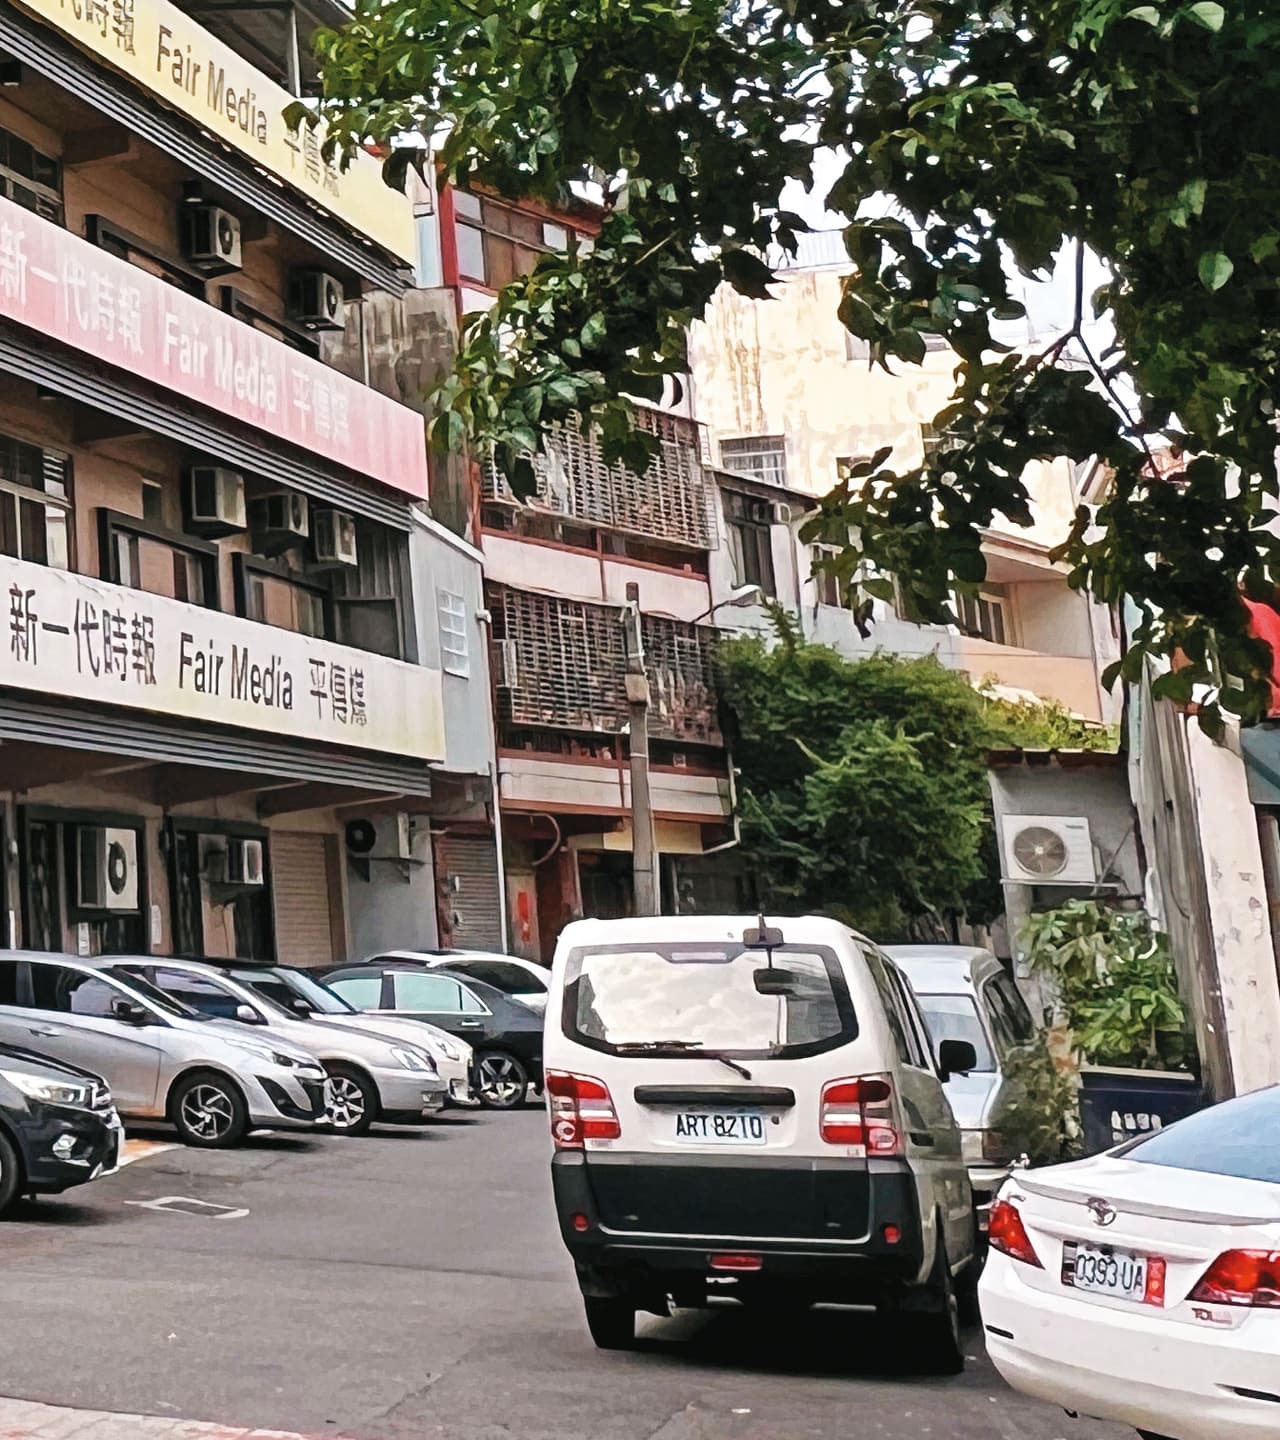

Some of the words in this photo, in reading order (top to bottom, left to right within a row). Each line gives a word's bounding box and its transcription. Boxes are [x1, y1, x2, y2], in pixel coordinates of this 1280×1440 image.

[157, 25, 201, 97] Fair
[208, 61, 269, 146] Media
[163, 311, 209, 378] Fair
[215, 335, 277, 414] Media
[8, 582, 157, 686] 新一代時報
[178, 631, 224, 696] Fair
[231, 644, 294, 711] Media
